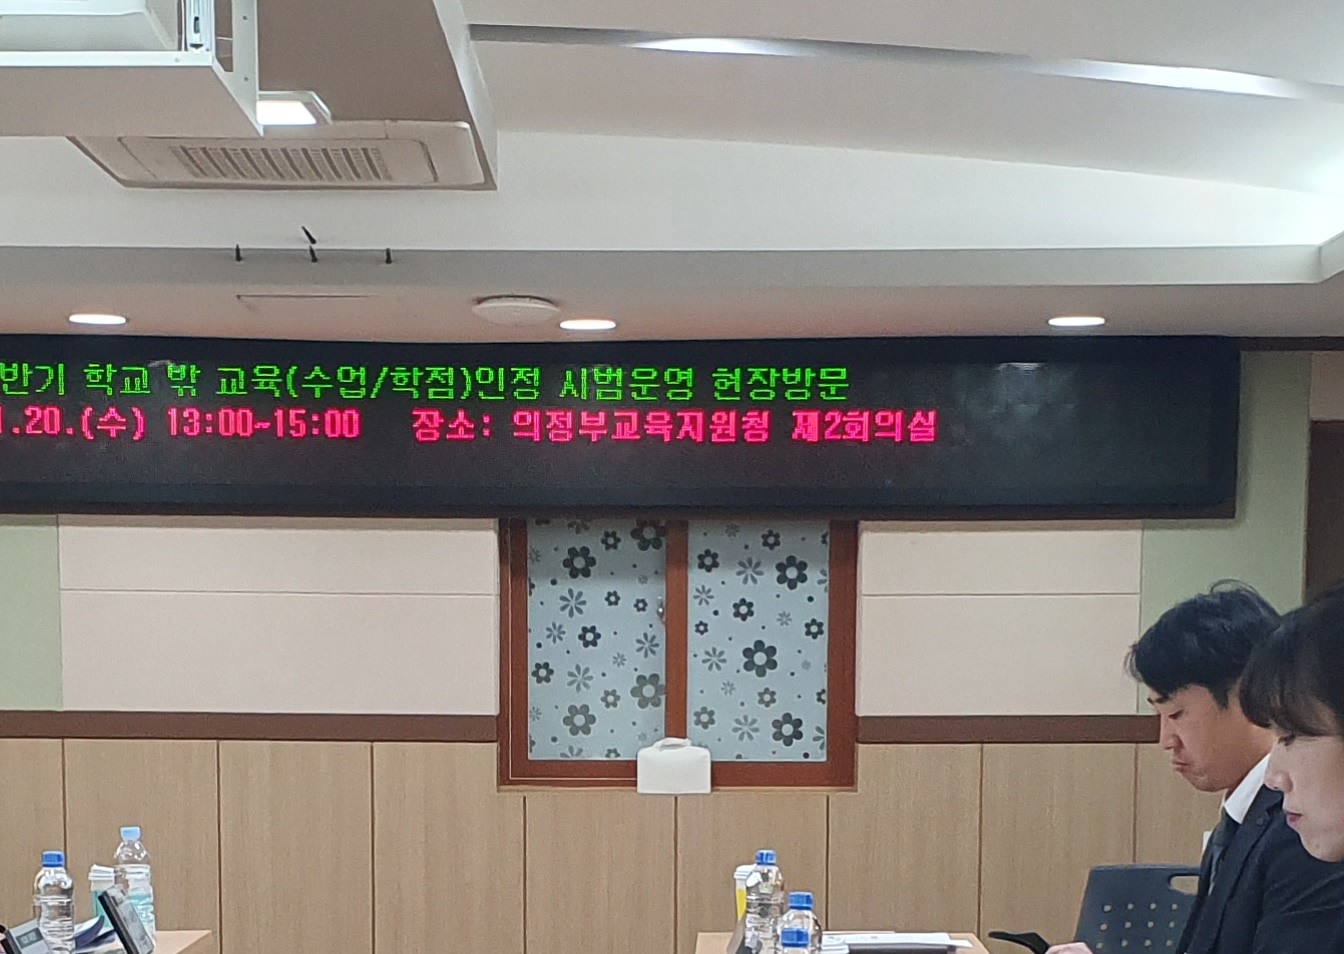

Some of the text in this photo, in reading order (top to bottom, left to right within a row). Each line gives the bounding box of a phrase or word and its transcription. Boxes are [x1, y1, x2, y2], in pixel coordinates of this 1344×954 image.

[82, 362, 152, 398] 학교
[165, 363, 203, 398] 밖
[217, 363, 542, 402] 교육(수업/학점)인정
[560, 366, 696, 402] 시범운영
[710, 366, 850, 402] 현장방문
[166, 406, 363, 440] 13:00~15:00
[411, 407, 493, 444] 장소:
[511, 408, 772, 445] 의정부교육지원청
[790, 408, 939, 445] 제2회의실
